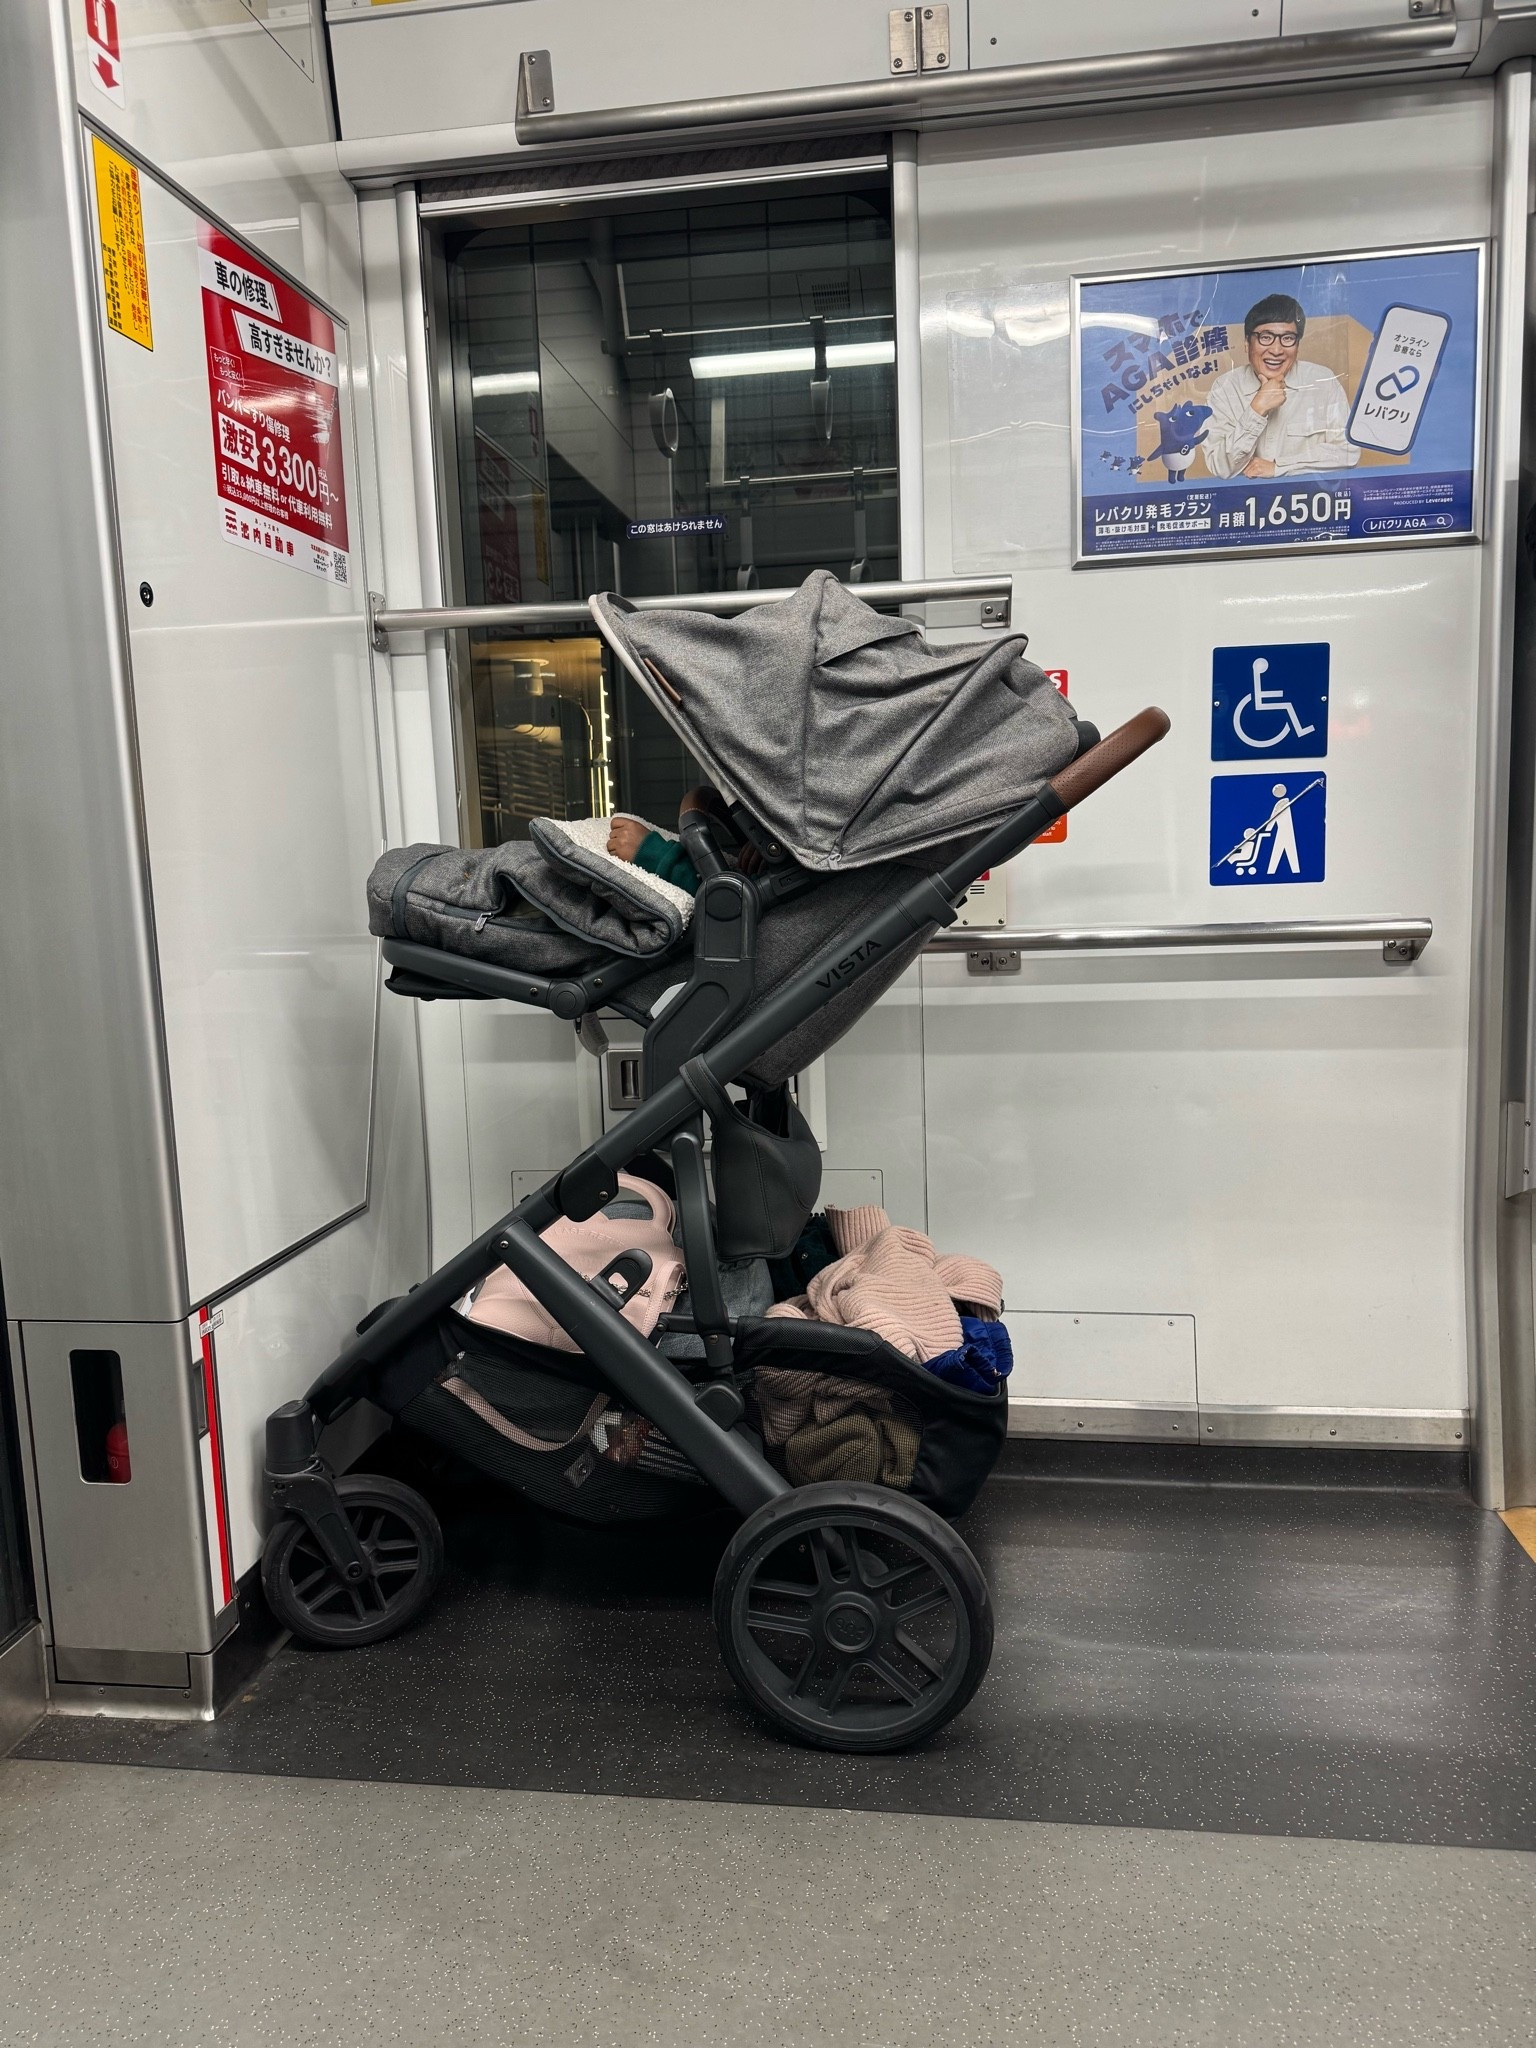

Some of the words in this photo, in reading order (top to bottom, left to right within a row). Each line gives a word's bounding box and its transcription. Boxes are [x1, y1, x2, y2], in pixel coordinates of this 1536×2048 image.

[214, 260, 274, 311] 車の修理、
[248, 322, 332, 377] 高すぎませんか?
[1393, 334, 1430, 348] オンライン
[1393, 343, 1422, 358] 診療なら
[1128, 359, 1219, 415] にしちゃいなよ!
[217, 389, 292, 443] バンパーすり傷修理
[1364, 403, 1410, 424] レバクリ
[221, 417, 255, 463] 激安
[288, 495, 333, 530] 代車利用無料
[1094, 502, 1212, 523] レバクリ発毛プラン
[1425, 496, 1453, 505] Leverages
[240, 521, 295, 558] 池内自動車
[630, 519, 723, 535] この窓はあけられません
[1370, 519, 1402, 530] レバクリ
[1404, 518, 1427, 529] AGA
[815, 939, 882, 989] VISTA
